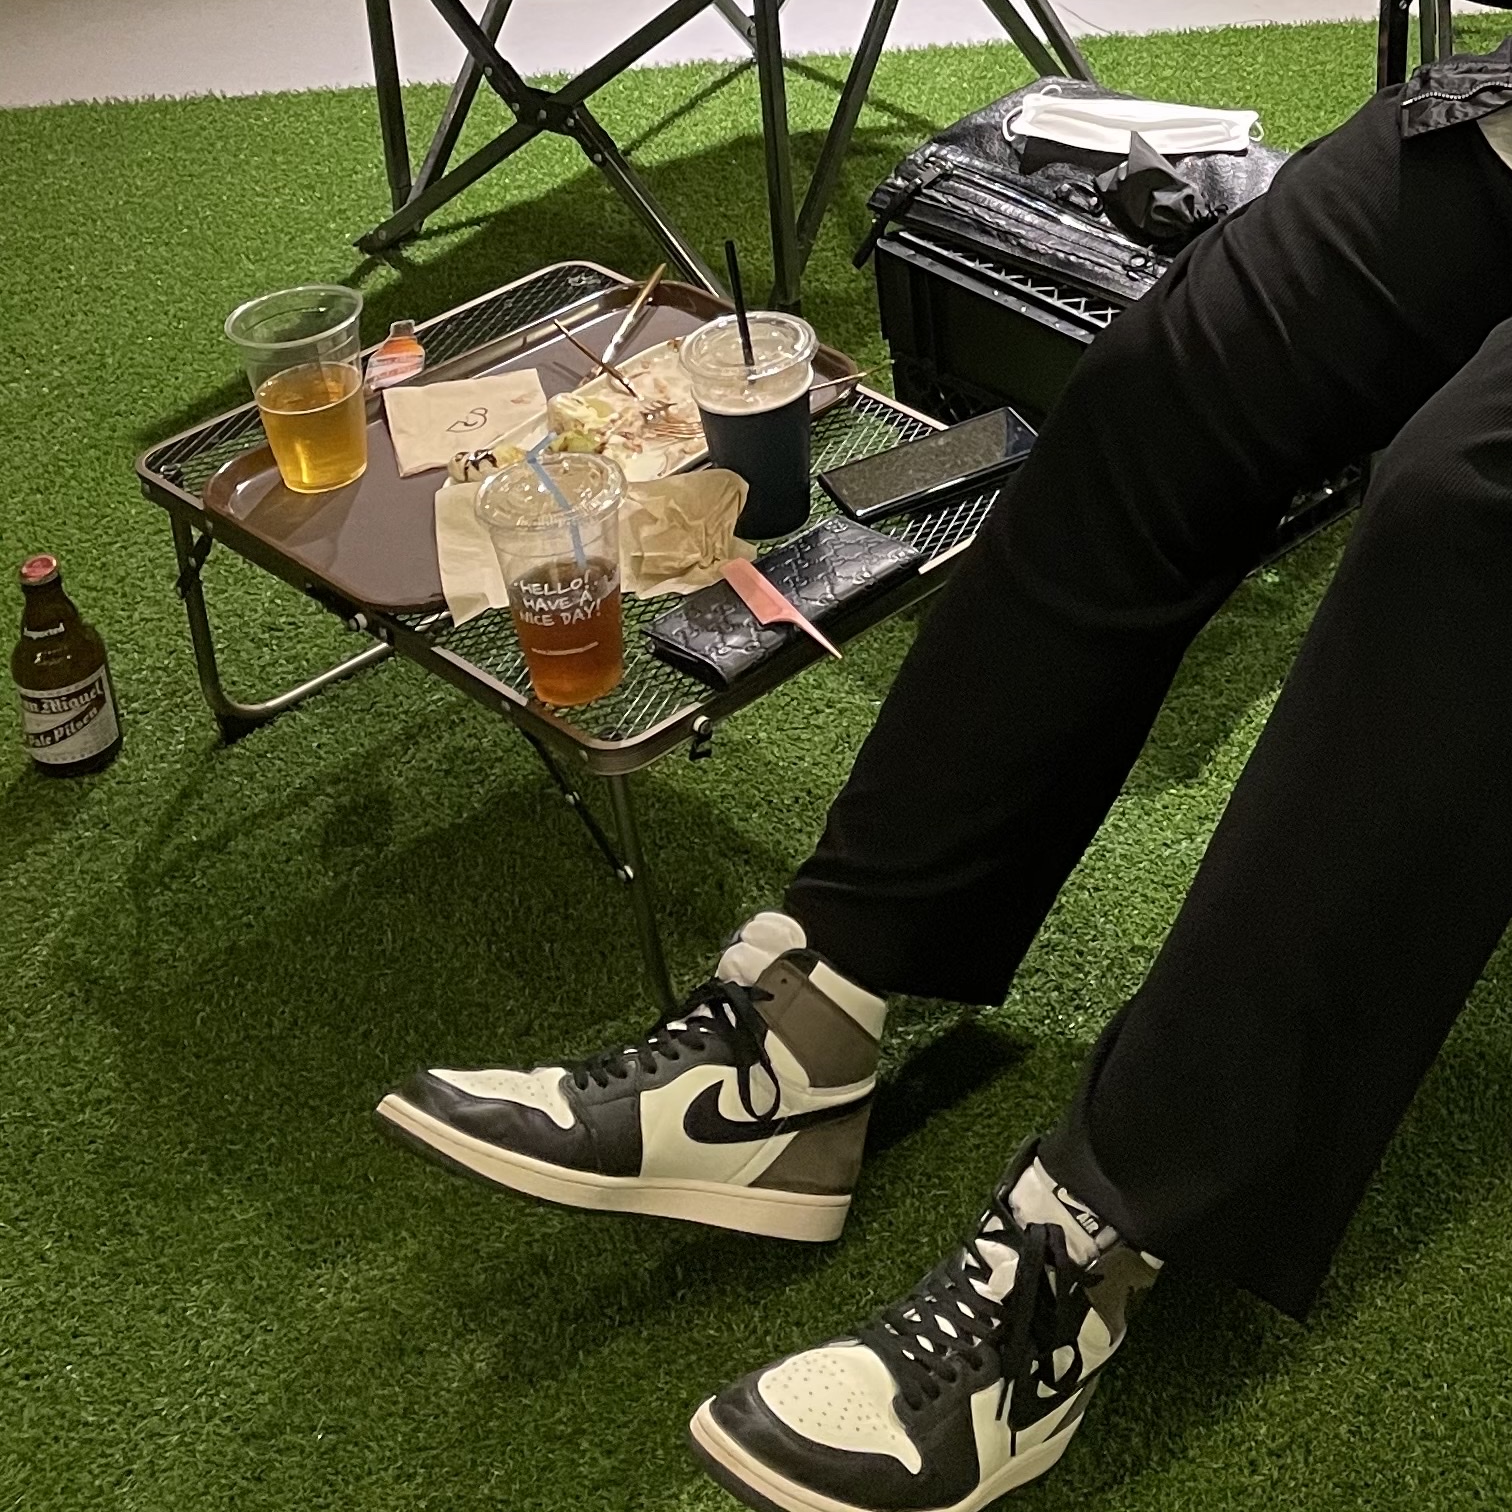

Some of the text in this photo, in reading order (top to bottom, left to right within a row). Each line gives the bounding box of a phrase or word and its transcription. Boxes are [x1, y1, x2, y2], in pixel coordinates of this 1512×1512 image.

[520, 598, 601, 627] NICE DAY!
[523, 589, 593, 612] HAVE A
